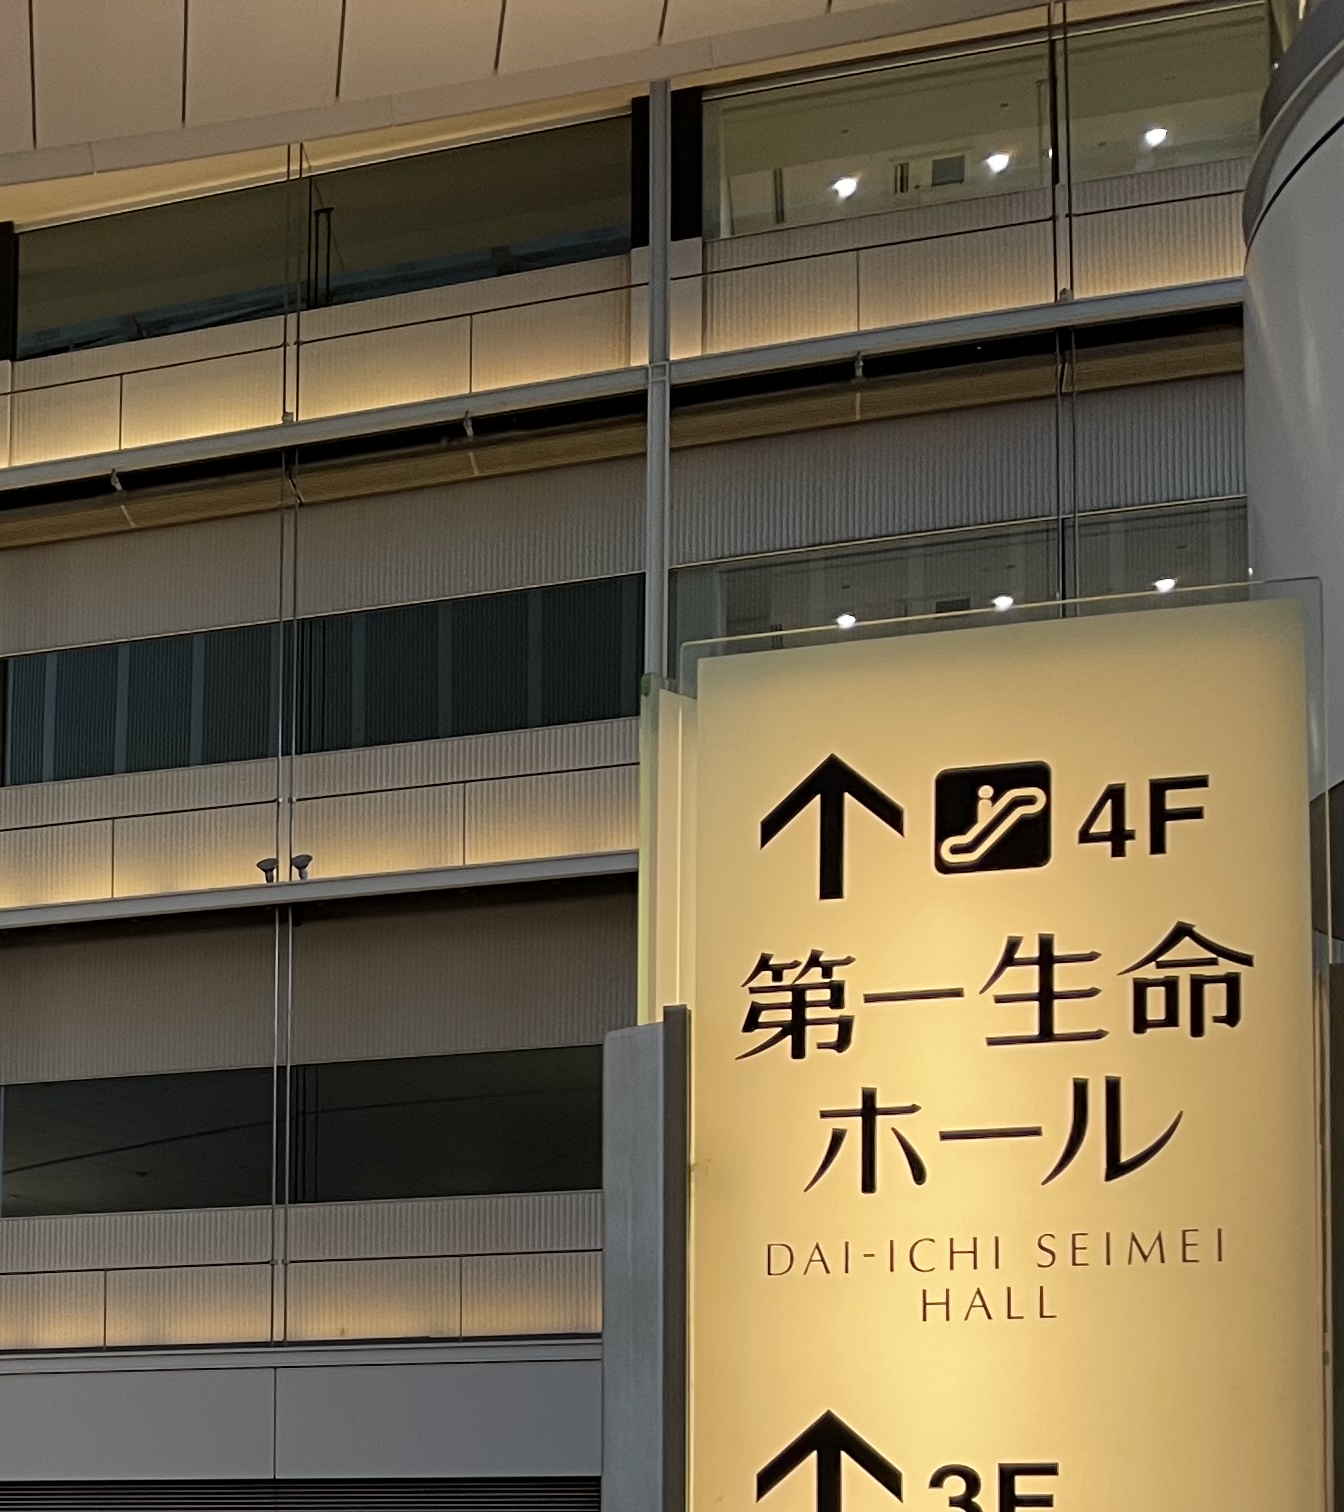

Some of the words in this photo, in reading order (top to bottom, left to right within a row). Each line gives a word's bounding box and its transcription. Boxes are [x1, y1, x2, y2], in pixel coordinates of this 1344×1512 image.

[1076, 773, 1211, 859] 4F
[734, 919, 1256, 1062] 第一生命
[803, 1075, 1185, 1196] ホール
[765, 1235, 1003, 1277] DAI-ICHI
[1036, 1227, 1227, 1270] SEIMEI
[920, 1285, 1059, 1323] HALL
